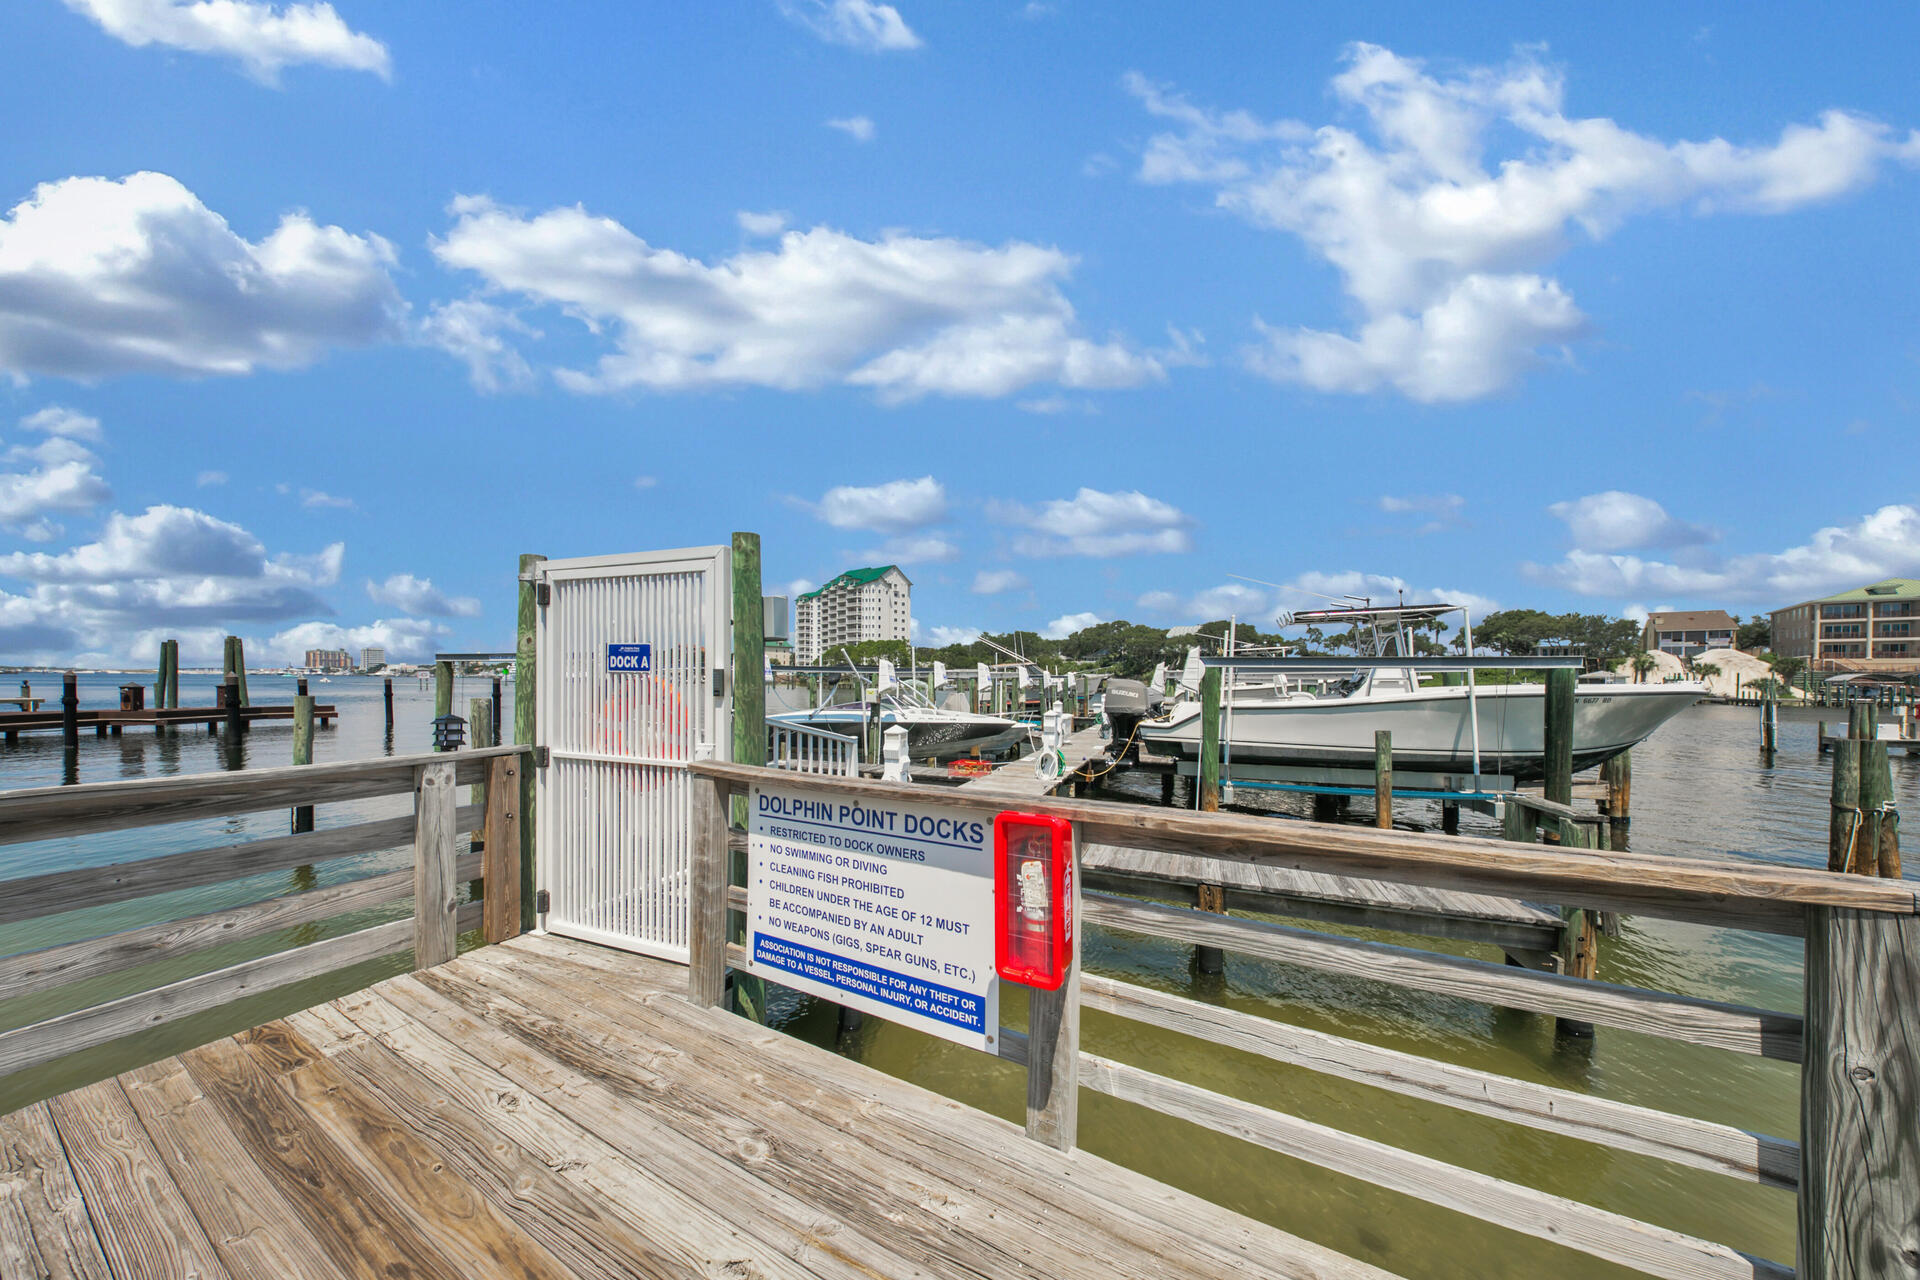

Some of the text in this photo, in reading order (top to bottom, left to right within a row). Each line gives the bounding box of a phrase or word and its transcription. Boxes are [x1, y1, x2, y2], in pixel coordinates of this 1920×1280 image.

[610, 656, 649, 668] DOCK A
[759, 794, 984, 844] DOLPHIN POINT DOCKS
[770, 826, 926, 862] RESTRICTED TO DOCK OWNERS
[770, 844, 888, 875] NO SWIMMING OR DIVING
[770, 862, 904, 898] CLEANING FISH PROHIBITED
[770, 880, 970, 935] CHILDREN UNDER THE AGE OF 12 MUST
[770, 898, 924, 945] BE ACCOMPANIED BY AN ADULT
[768, 916, 976, 984] NO WEAPONS (GIGS, SPEAR GUNS, ETC.)
[756, 950, 981, 1027] DAMAGE TO A VESSEL, PERSONAL INJURY, OR ACCIDENT.
[760, 939, 976, 1012] ASSOCIATION IS NOT RESPONSIBLE FOR ANY THEFT OR
